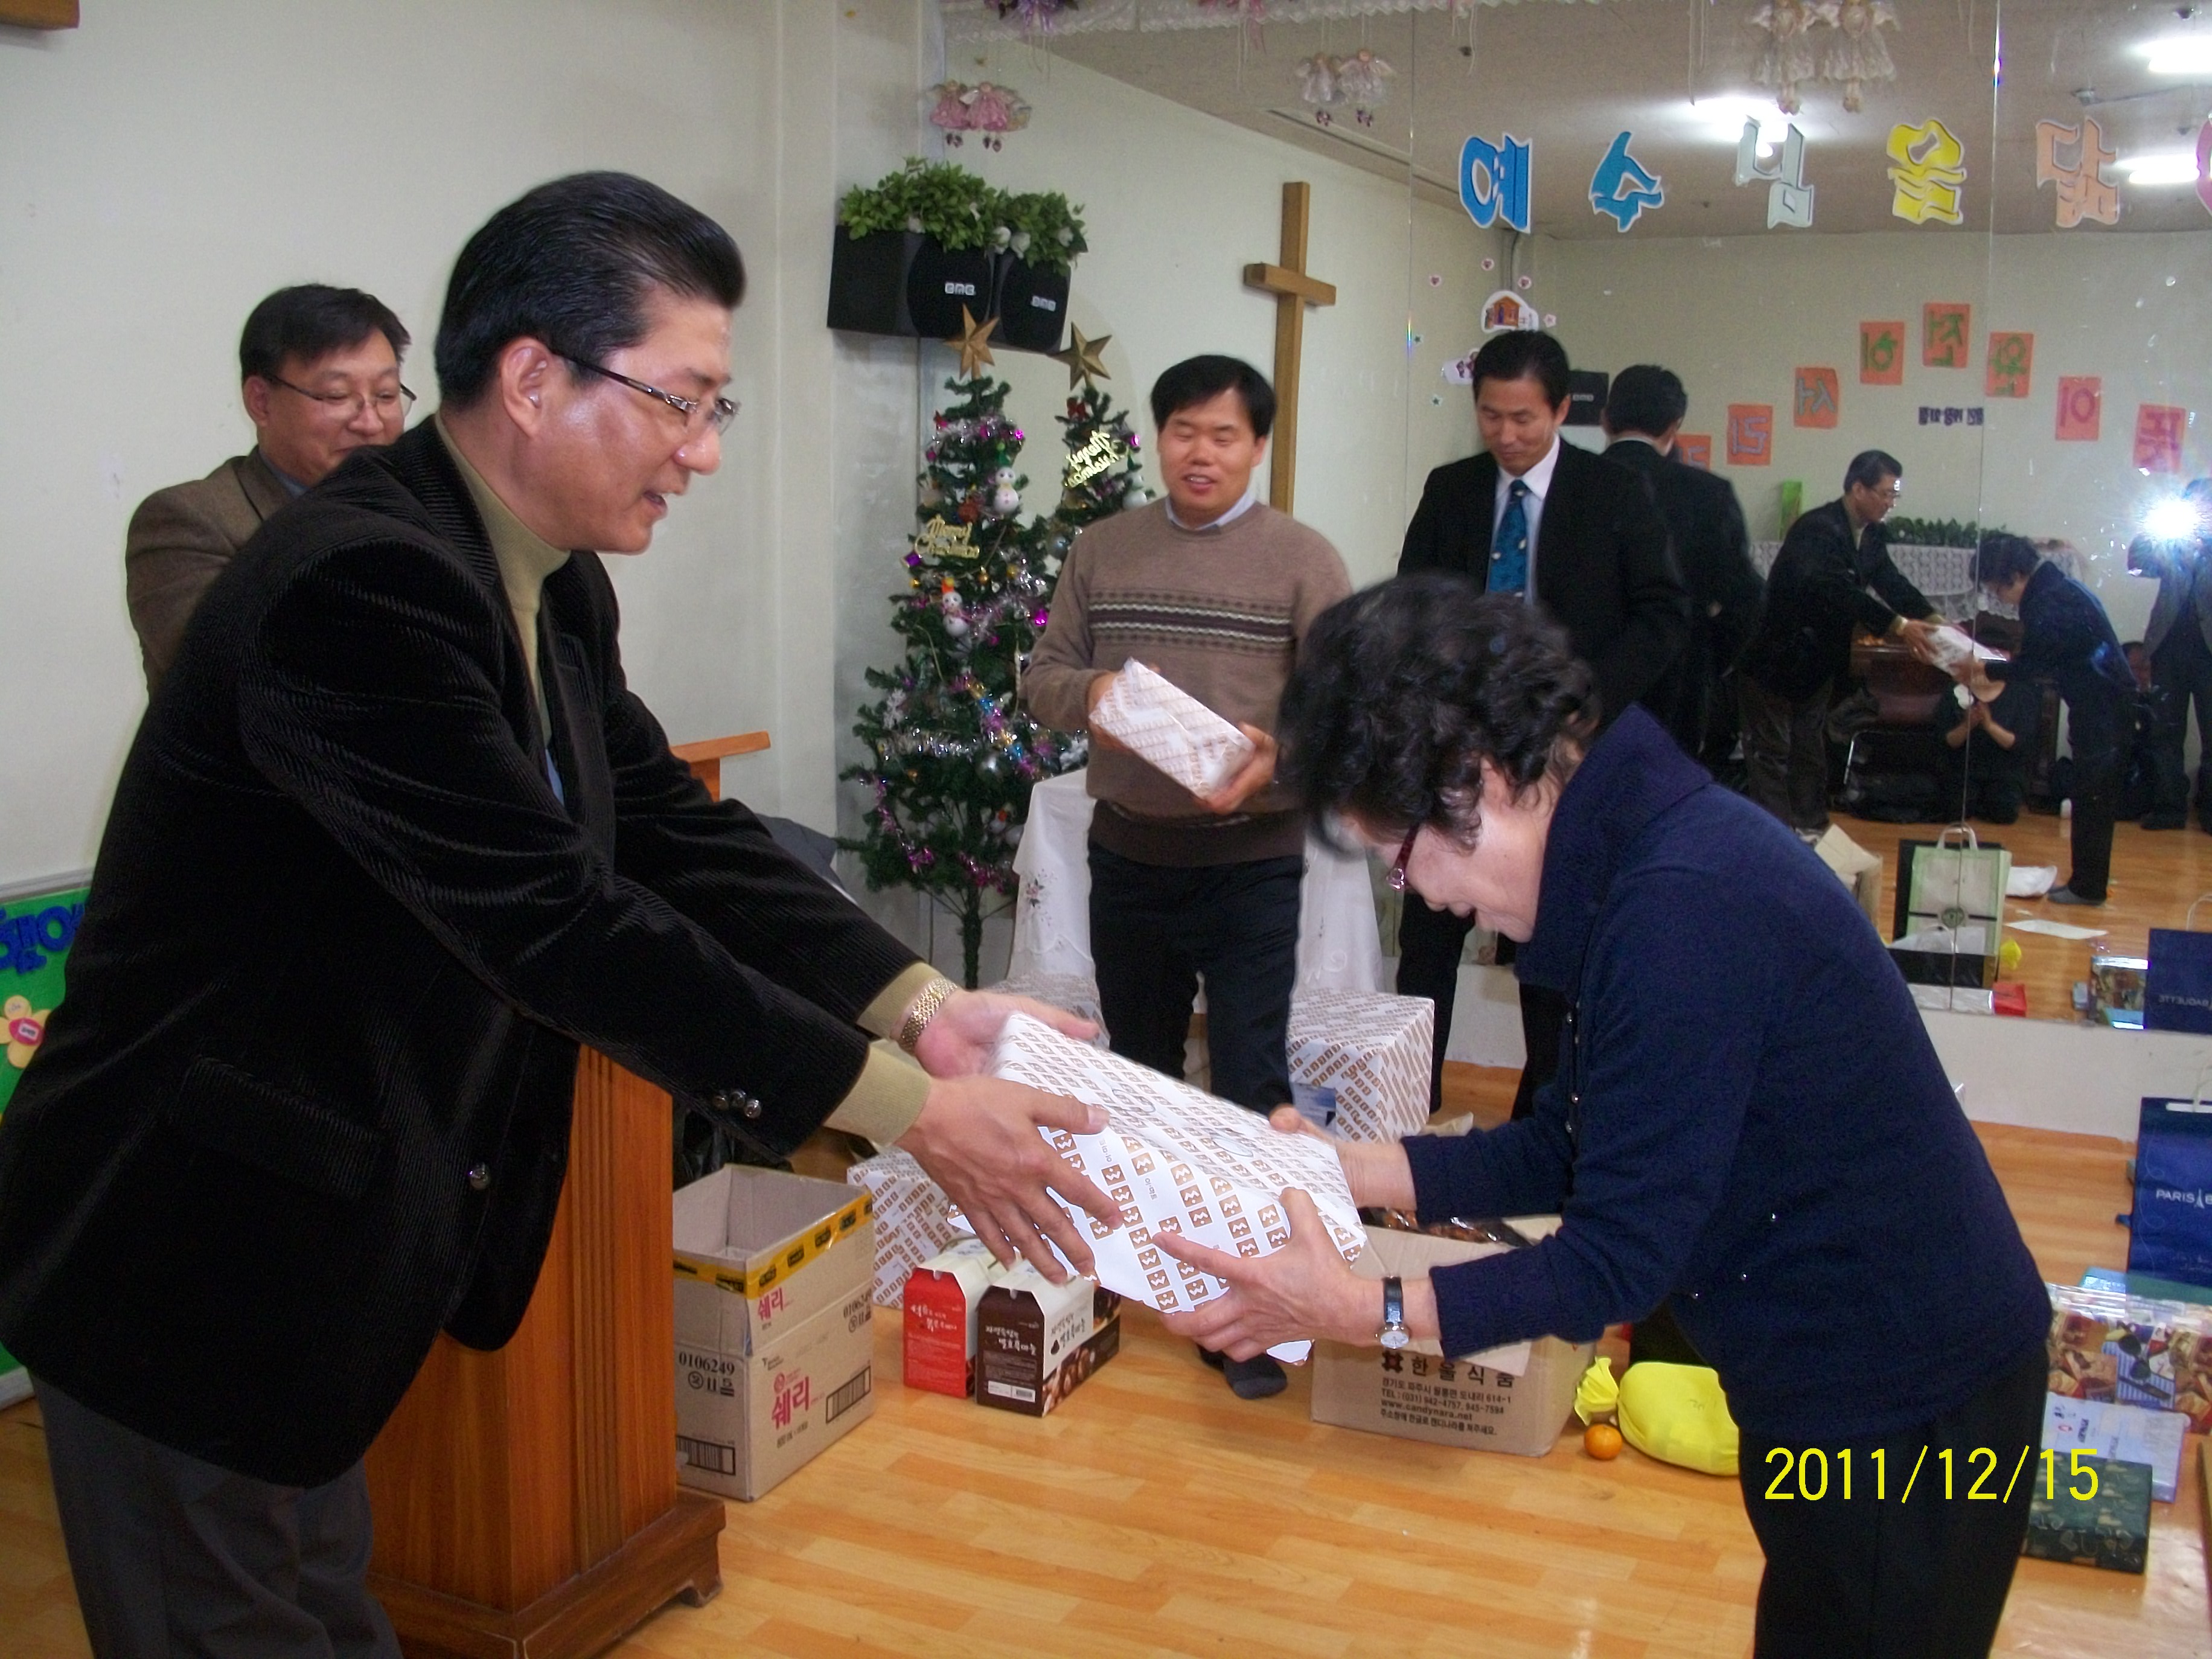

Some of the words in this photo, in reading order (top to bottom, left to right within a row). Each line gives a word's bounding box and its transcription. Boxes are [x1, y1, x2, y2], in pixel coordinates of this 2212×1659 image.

[1459, 118, 1968, 233] 예수님을
[2156, 1188, 2195, 1204] PARIS
[679, 1351, 735, 1375] 0106249
[1402, 1391, 1422, 1404] (031)
[1486, 1392, 1511, 1404] 614-1
[1381, 1399, 1473, 1421] www.candynara.net
[1408, 1414, 1430, 1426] 한글로
